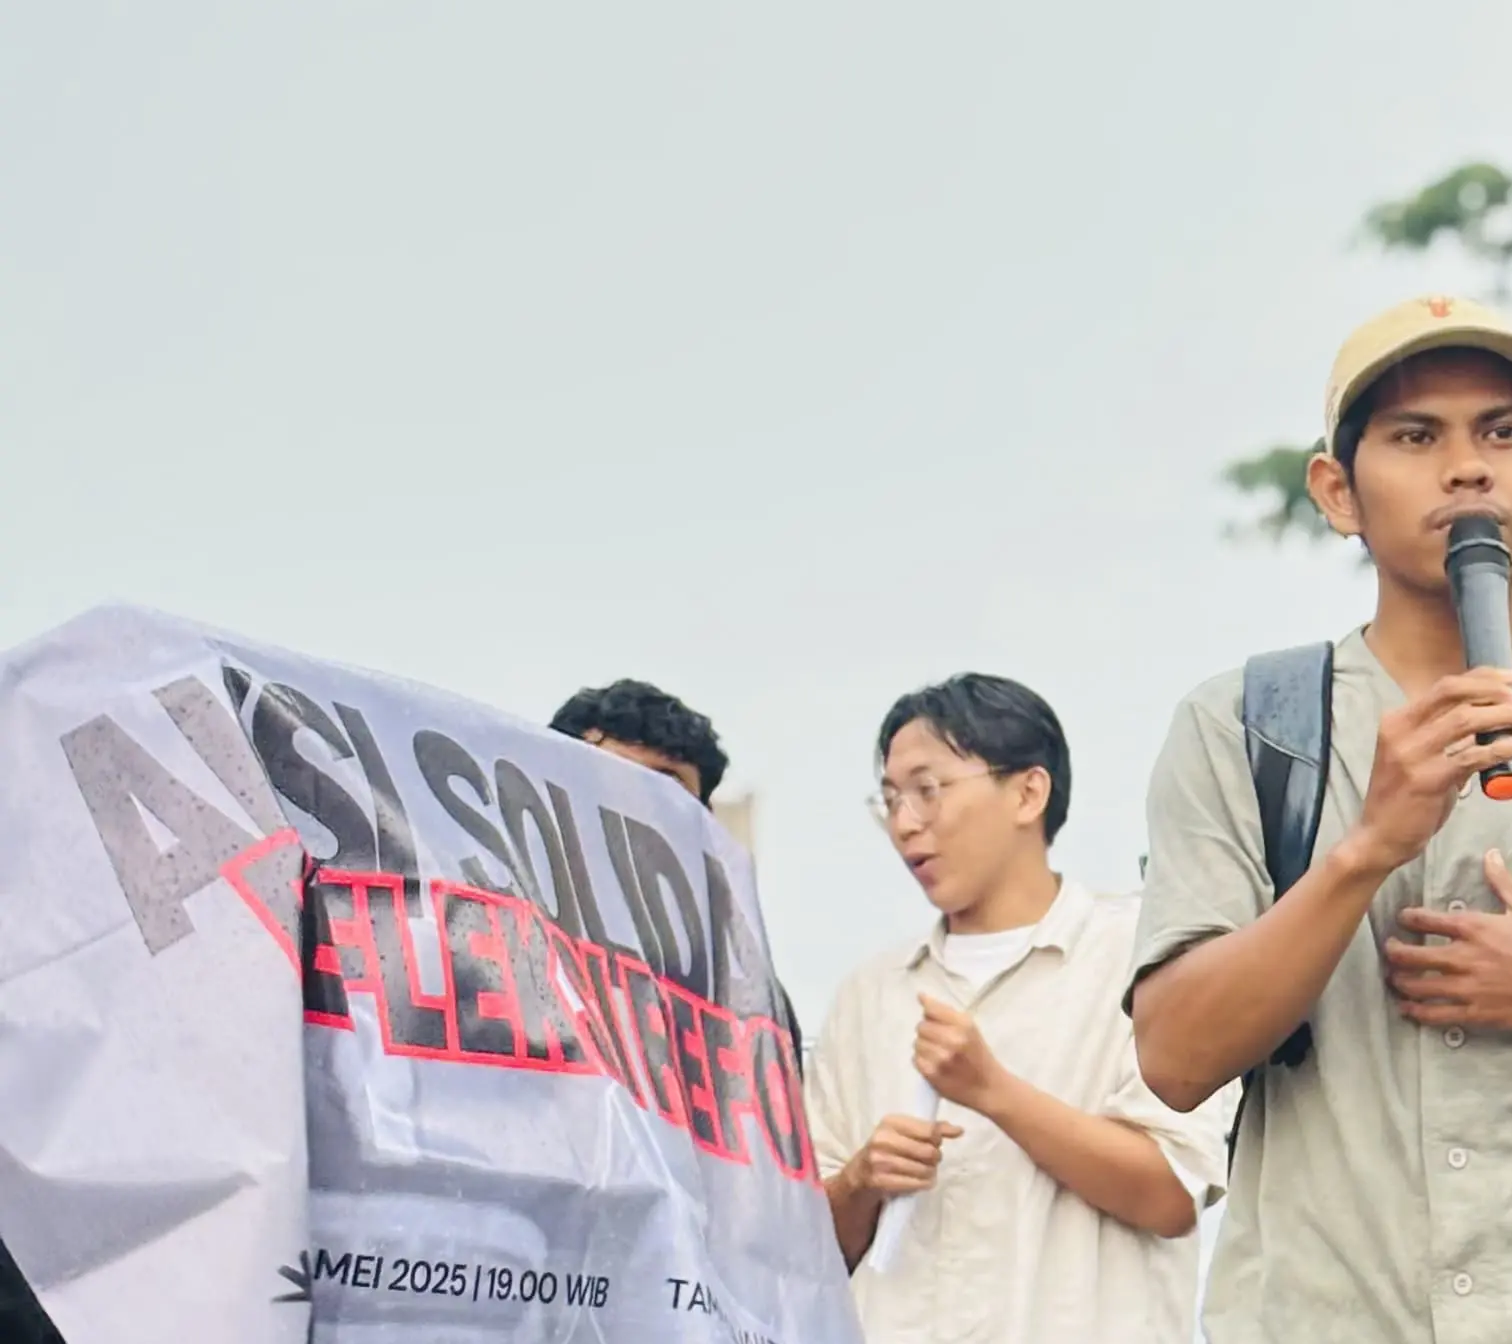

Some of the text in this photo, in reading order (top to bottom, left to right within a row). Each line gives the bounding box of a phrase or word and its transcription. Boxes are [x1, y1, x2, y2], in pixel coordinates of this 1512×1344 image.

[413, 728, 790, 1022] SOLIDA
[313, 1249, 383, 1289] MEI
[388, 1258, 467, 1297] 2025
[487, 1267, 557, 1305] 19.00
[566, 1274, 610, 1308] WIB
